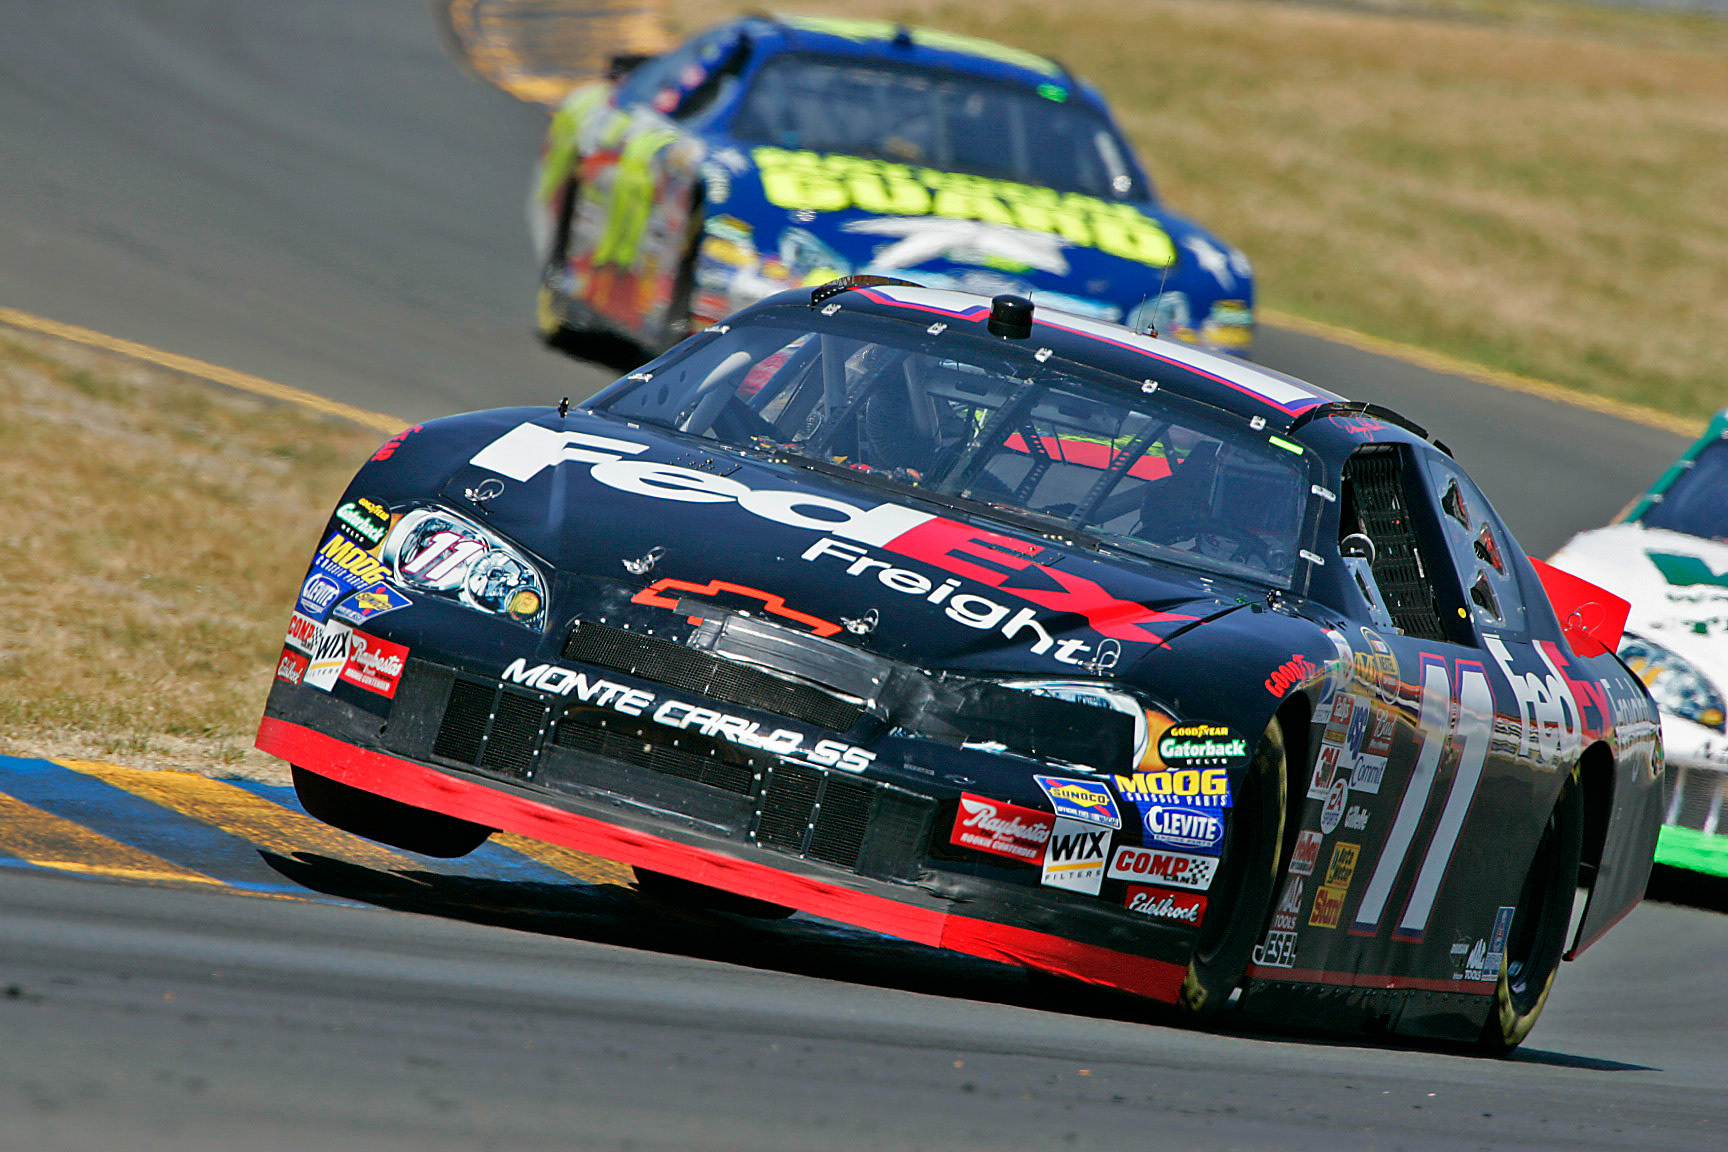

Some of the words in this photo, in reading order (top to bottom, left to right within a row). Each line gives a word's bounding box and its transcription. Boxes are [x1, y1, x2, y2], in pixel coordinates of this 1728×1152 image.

[469, 421, 1206, 650] FedEx
[320, 533, 393, 585] MOOG
[401, 530, 489, 582] 11
[801, 537, 1085, 666] Freight
[287, 615, 315, 642] COMP
[315, 631, 350, 661] WIX
[501, 657, 656, 717] MONTE
[652, 699, 805, 756] CARLO
[805, 738, 878, 775] SS
[1170, 724, 1229, 738] GOODYEAR
[1160, 738, 1247, 759] Gatorback
[1114, 769, 1228, 796] MOOG
[1350, 755, 1386, 787] Commit
[1052, 786, 1107, 804] SUNOCO
[1125, 791, 1180, 805] CHASSIS
[1186, 794, 1229, 807] PARTS
[1339, 651, 1498, 944] 11
[1149, 805, 1217, 840] CLEVITE
[1051, 830, 1110, 862] WIX
[1044, 869, 1101, 882] FILTERS
[1115, 850, 1190, 876] COMP
[1163, 873, 1199, 886] CAMS
[1128, 892, 1201, 922] Edelbrock
[1273, 914, 1297, 930] TOOLS
